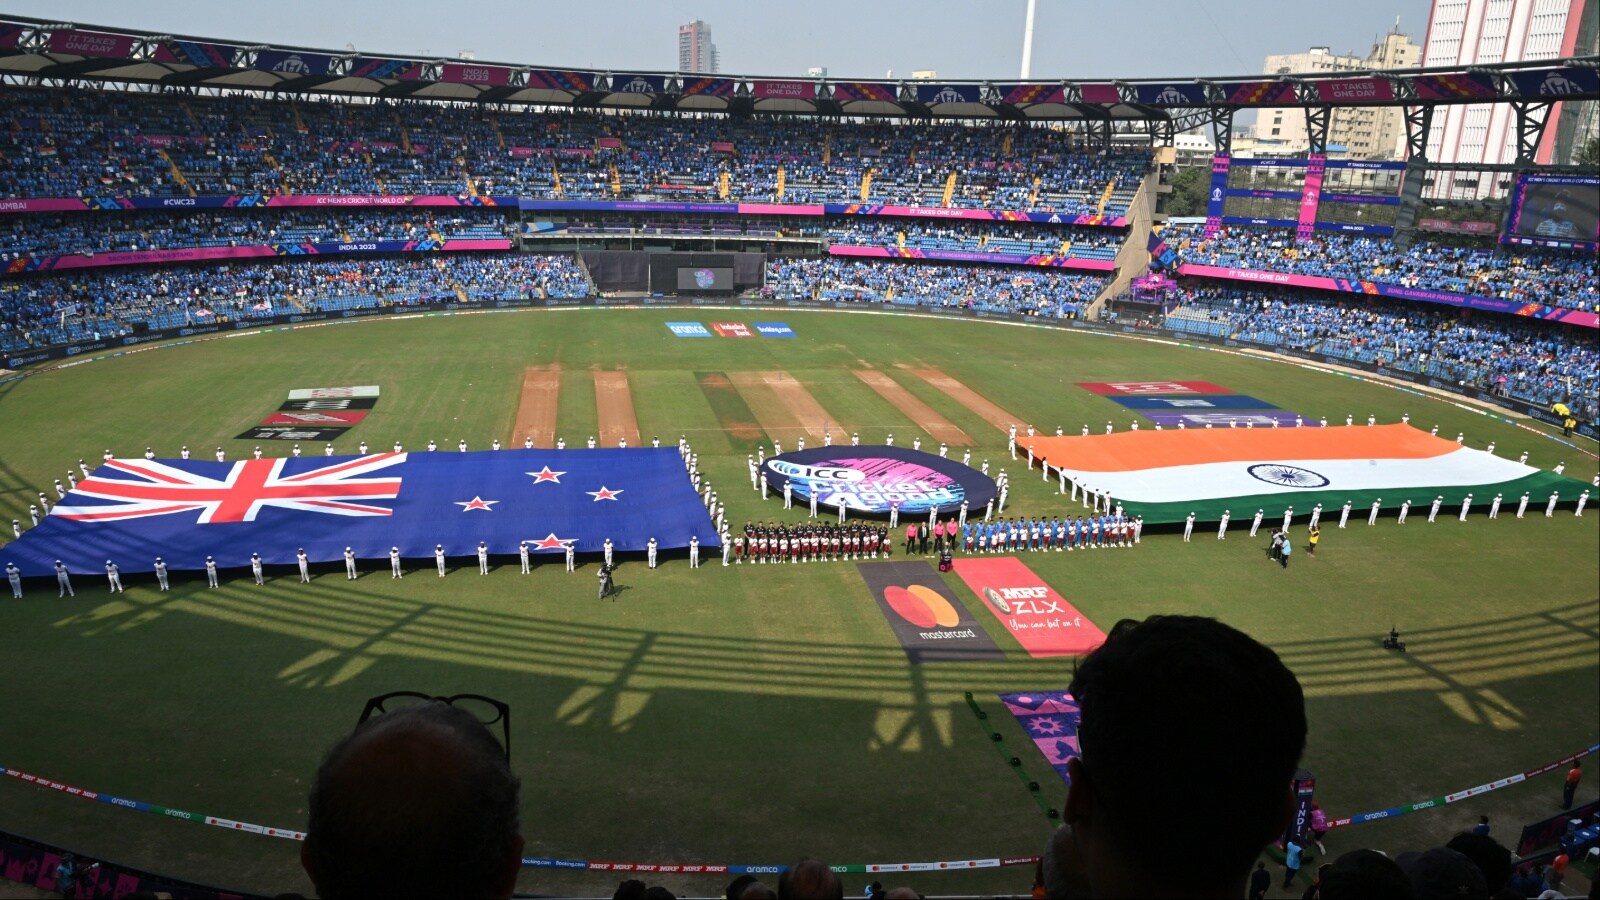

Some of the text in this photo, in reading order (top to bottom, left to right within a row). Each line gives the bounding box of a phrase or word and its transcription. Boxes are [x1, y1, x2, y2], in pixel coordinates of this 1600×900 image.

[65, 42, 90, 50] ONE
[82, 36, 117, 45] TAKES
[669, 326, 706, 334] aramco
[805, 467, 850, 480] ICC
[809, 480, 938, 494] Cricket
[1000, 586, 1049, 599] MRF
[1012, 601, 1065, 615] ZLX
[1009, 619, 1028, 631] You
[1047, 618, 1060, 628] bet
[1074, 618, 1080, 627] it
[920, 629, 976, 640] mastercard
[112, 797, 136, 808] aramco
[1412, 799, 1434, 810] aramco
[165, 808, 191, 819] aramco
[1364, 811, 1388, 820] aramco
